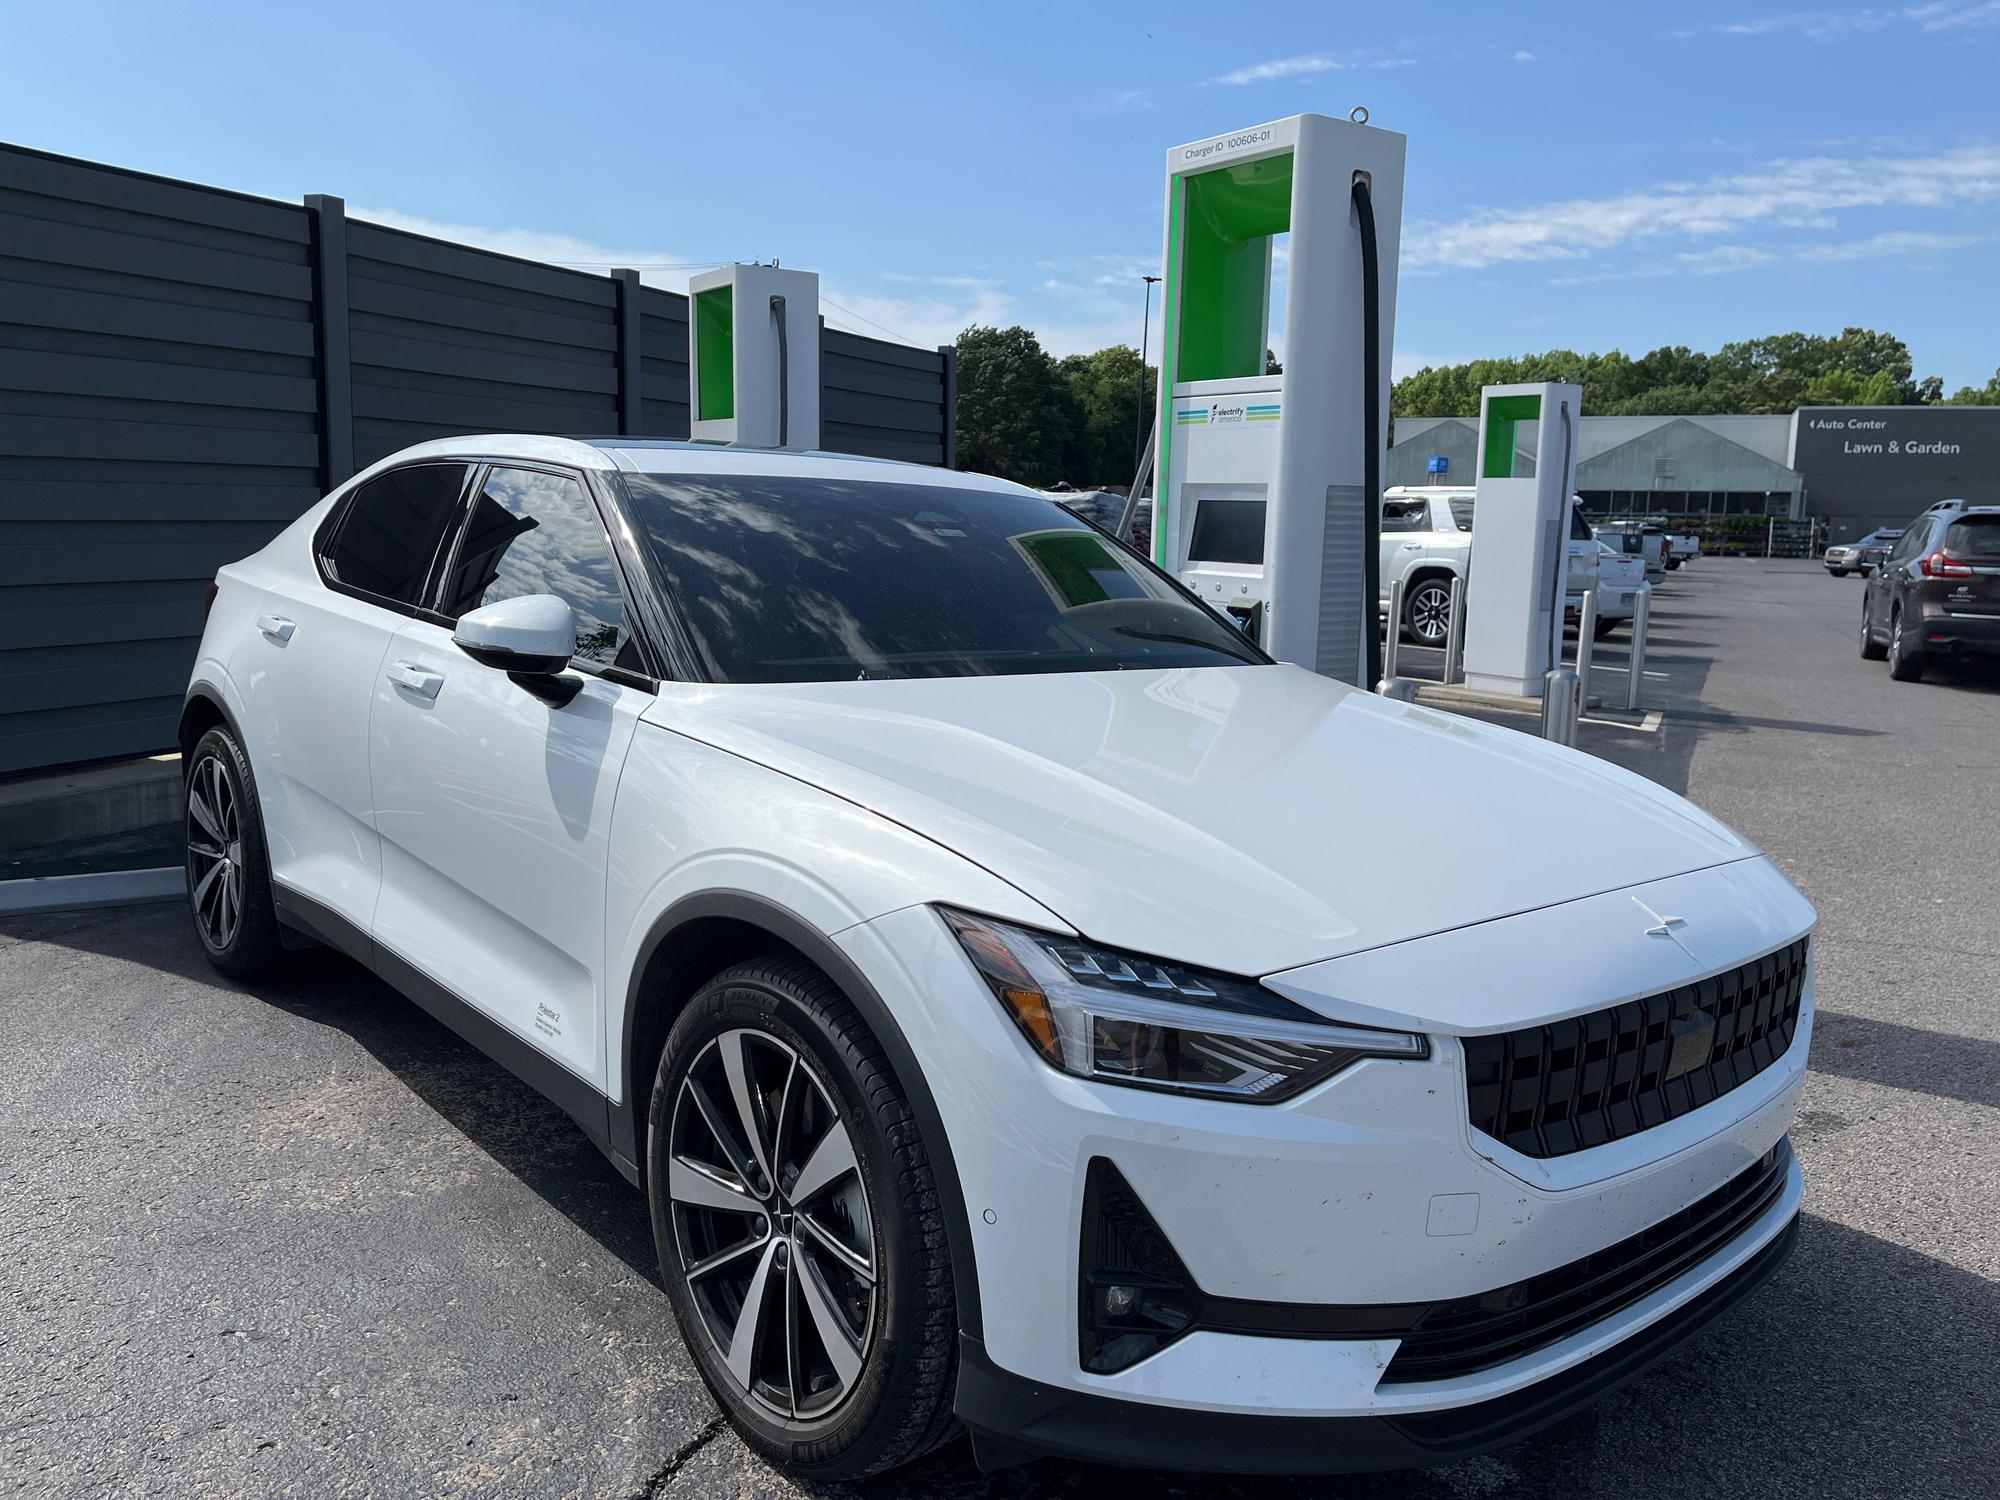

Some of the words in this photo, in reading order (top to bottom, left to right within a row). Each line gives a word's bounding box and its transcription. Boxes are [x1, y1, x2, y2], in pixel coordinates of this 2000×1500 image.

[1185, 145, 1215, 159] Charger
[1215, 142, 1223, 152] ID
[1227, 131, 1270, 149] 100606-01
[1218, 408, 1244, 416] electrify
[1816, 419, 1844, 430] Auto
[1847, 419, 1887, 430] Center
[1844, 441, 1882, 454] Lawn
[1888, 441, 1899, 454] &
[1905, 441, 1960, 454] Garden
[731, 990, 767, 1006] PRIMACY
